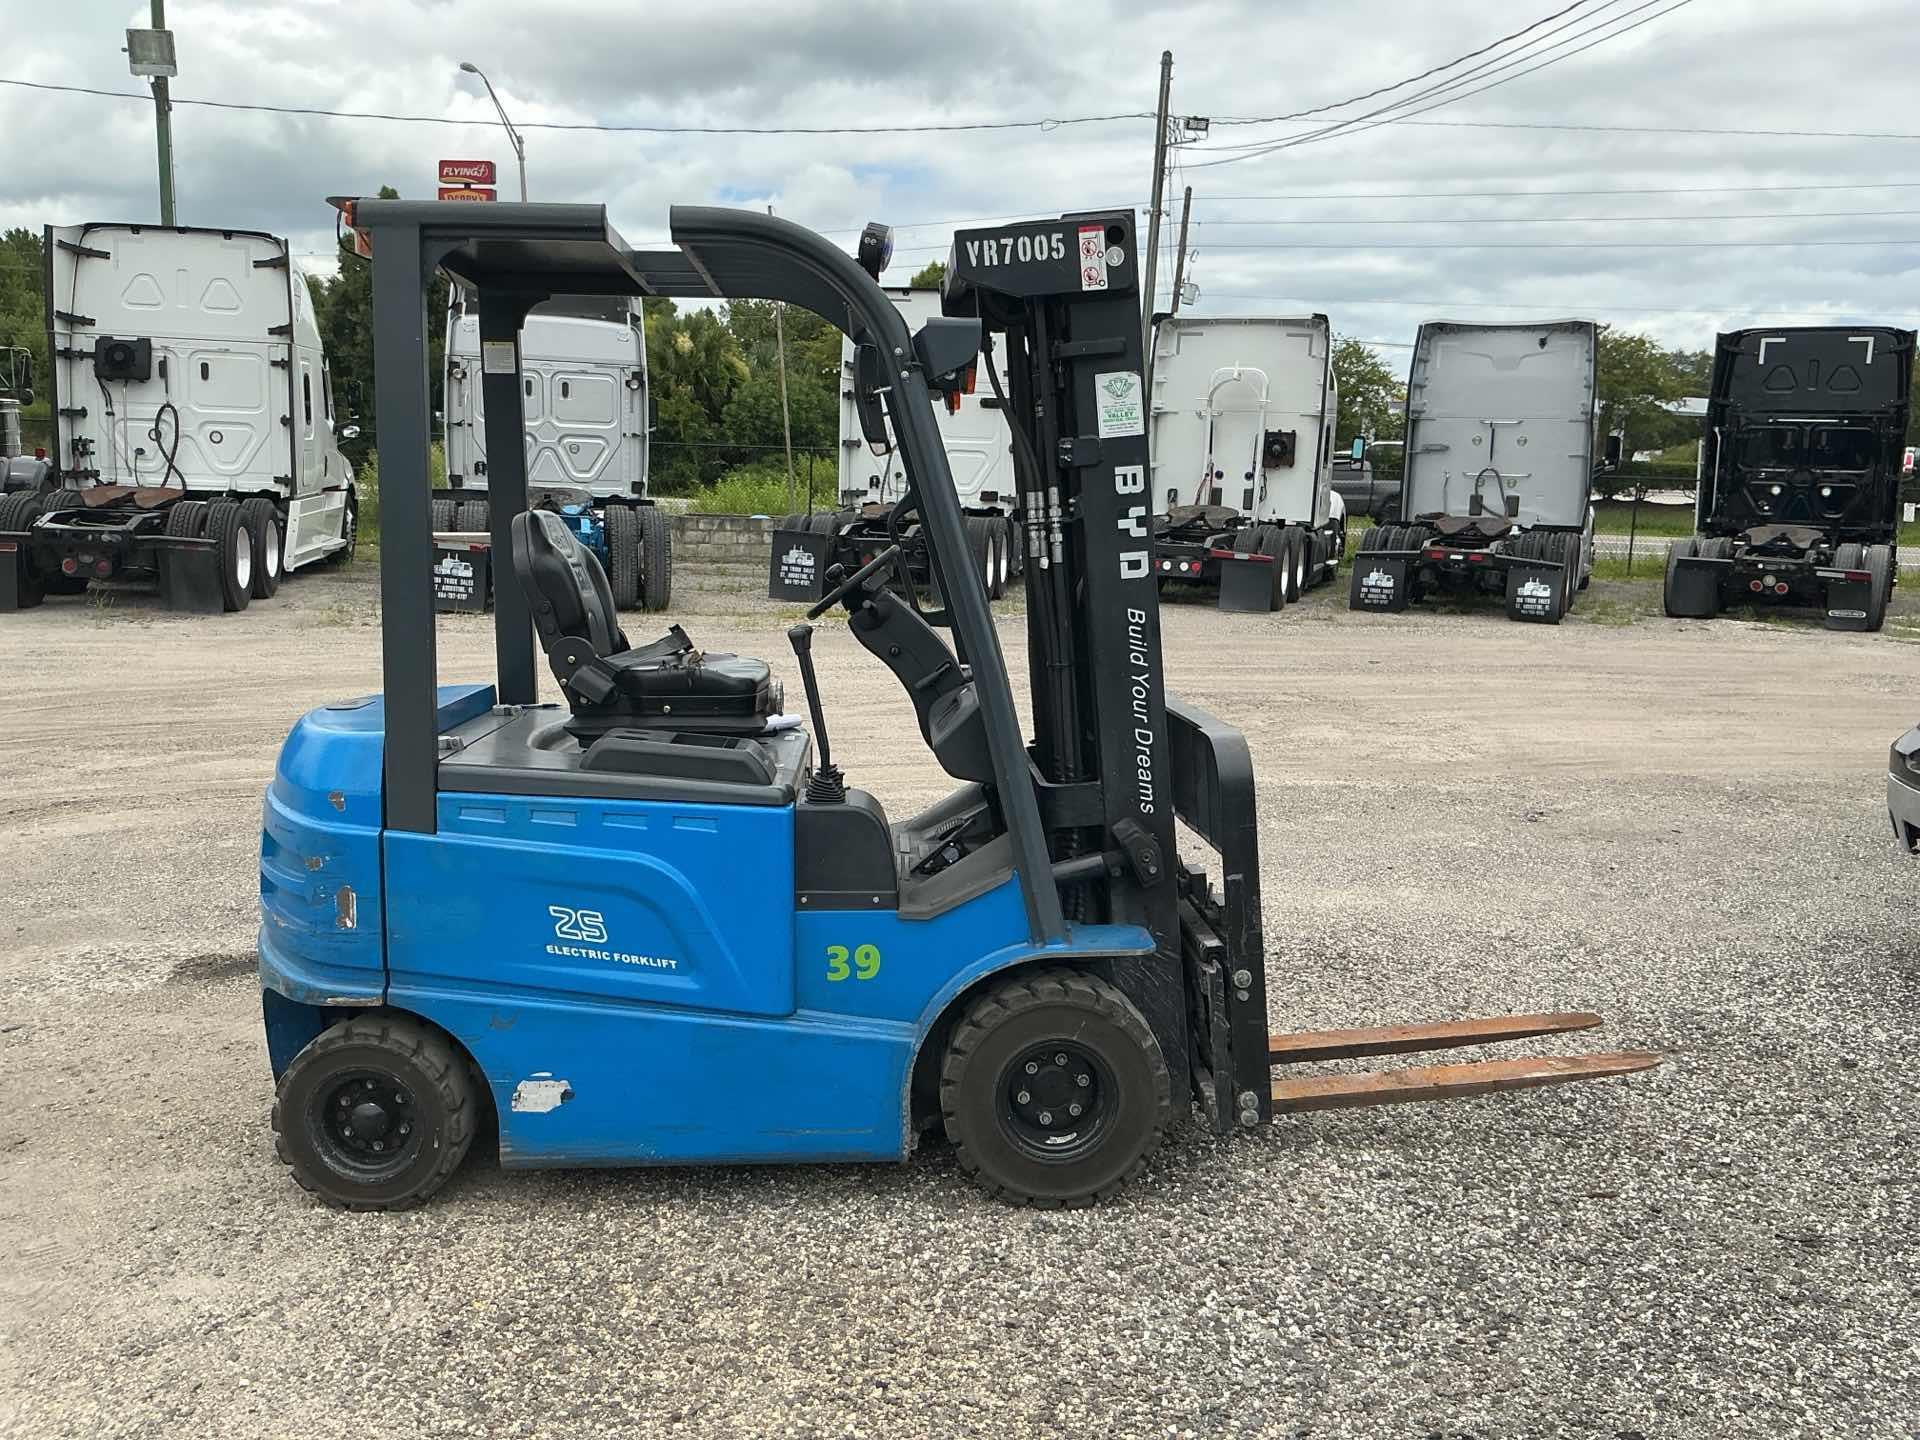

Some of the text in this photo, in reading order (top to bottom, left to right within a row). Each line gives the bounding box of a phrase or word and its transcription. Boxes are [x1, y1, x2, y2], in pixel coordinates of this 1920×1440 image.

[443, 167, 477, 176] FLYING
[965, 233, 1065, 268] VR7005
[1114, 465, 1150, 580] BYD
[1127, 608, 1155, 814] Build Your Dreams
[545, 944, 678, 969] ELECTRIC FORKLIFT
[826, 944, 881, 981] 39
